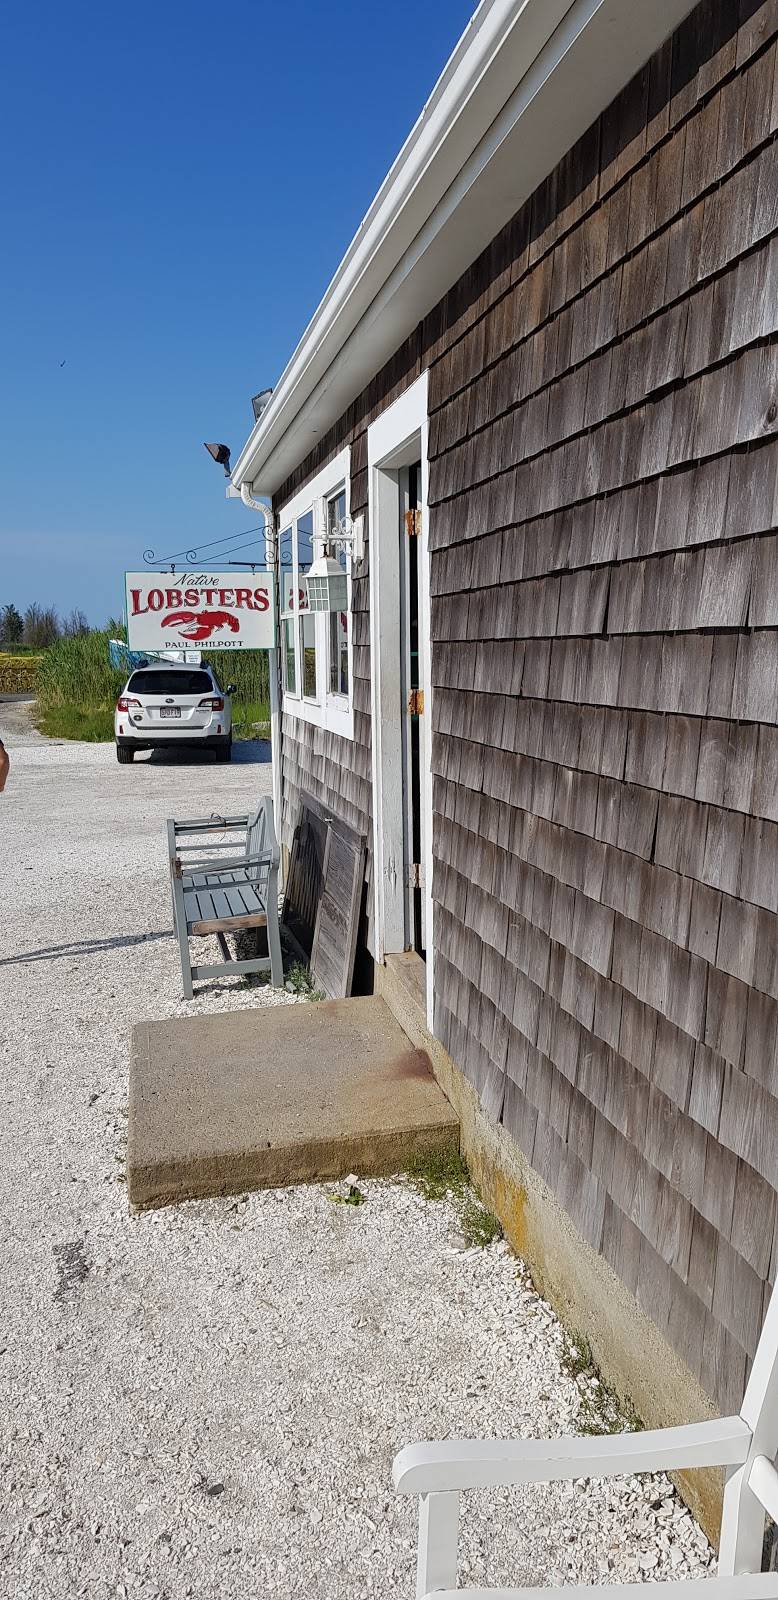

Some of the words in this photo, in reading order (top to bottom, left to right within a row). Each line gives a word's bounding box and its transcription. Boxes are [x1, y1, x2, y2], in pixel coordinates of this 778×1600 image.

[173, 573, 220, 586] Native
[130, 588, 270, 616] LOBSTERS
[165, 641, 191, 649] PAUL
[194, 640, 244, 648] PHILPOTT
